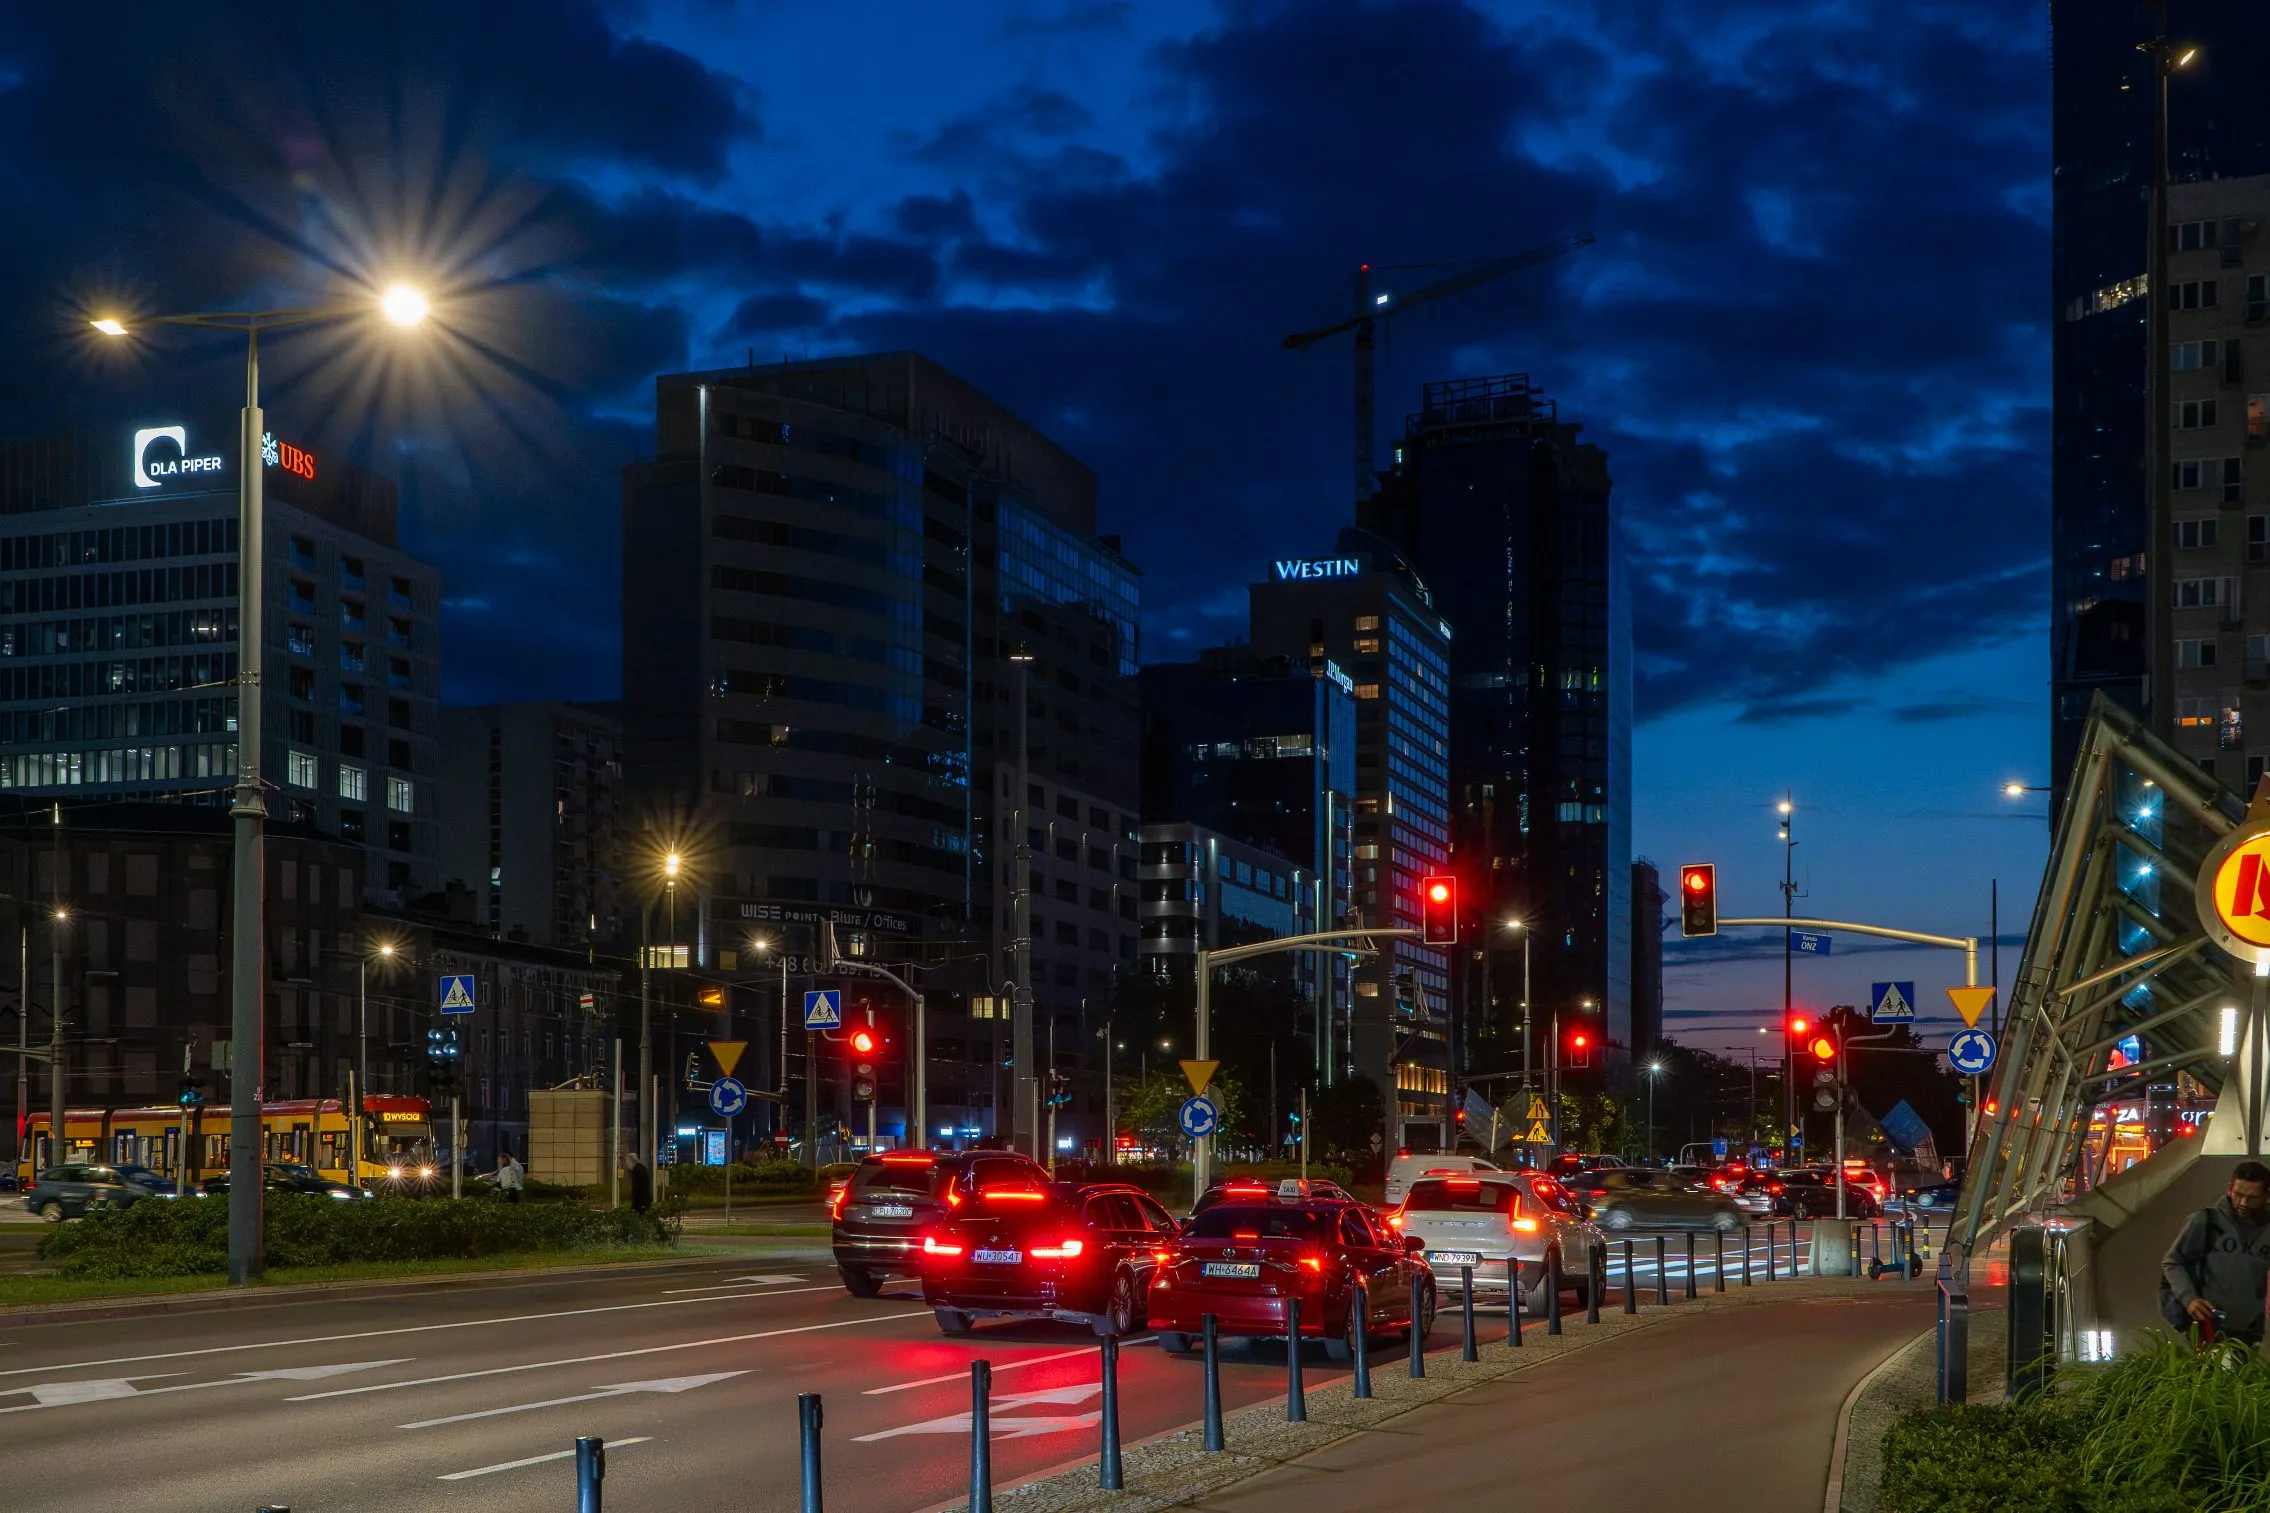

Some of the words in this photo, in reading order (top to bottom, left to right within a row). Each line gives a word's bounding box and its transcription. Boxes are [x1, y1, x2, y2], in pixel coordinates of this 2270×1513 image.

[150, 460, 178, 476] DLA
[181, 456, 222, 473] PIPER
[279, 441, 315, 480] UBS
[1275, 558, 1359, 580] WESTIN
[741, 904, 781, 919] WISE
[785, 911, 818, 923] POINT
[873, 914, 908, 931] Offices
[1801, 941, 1817, 951] ONZ
[383, 1112, 391, 1121] 10
[976, 1251, 989, 1261] WU
[1208, 1265, 1222, 1275] WH
[1224, 1265, 1257, 1276] 6464A
